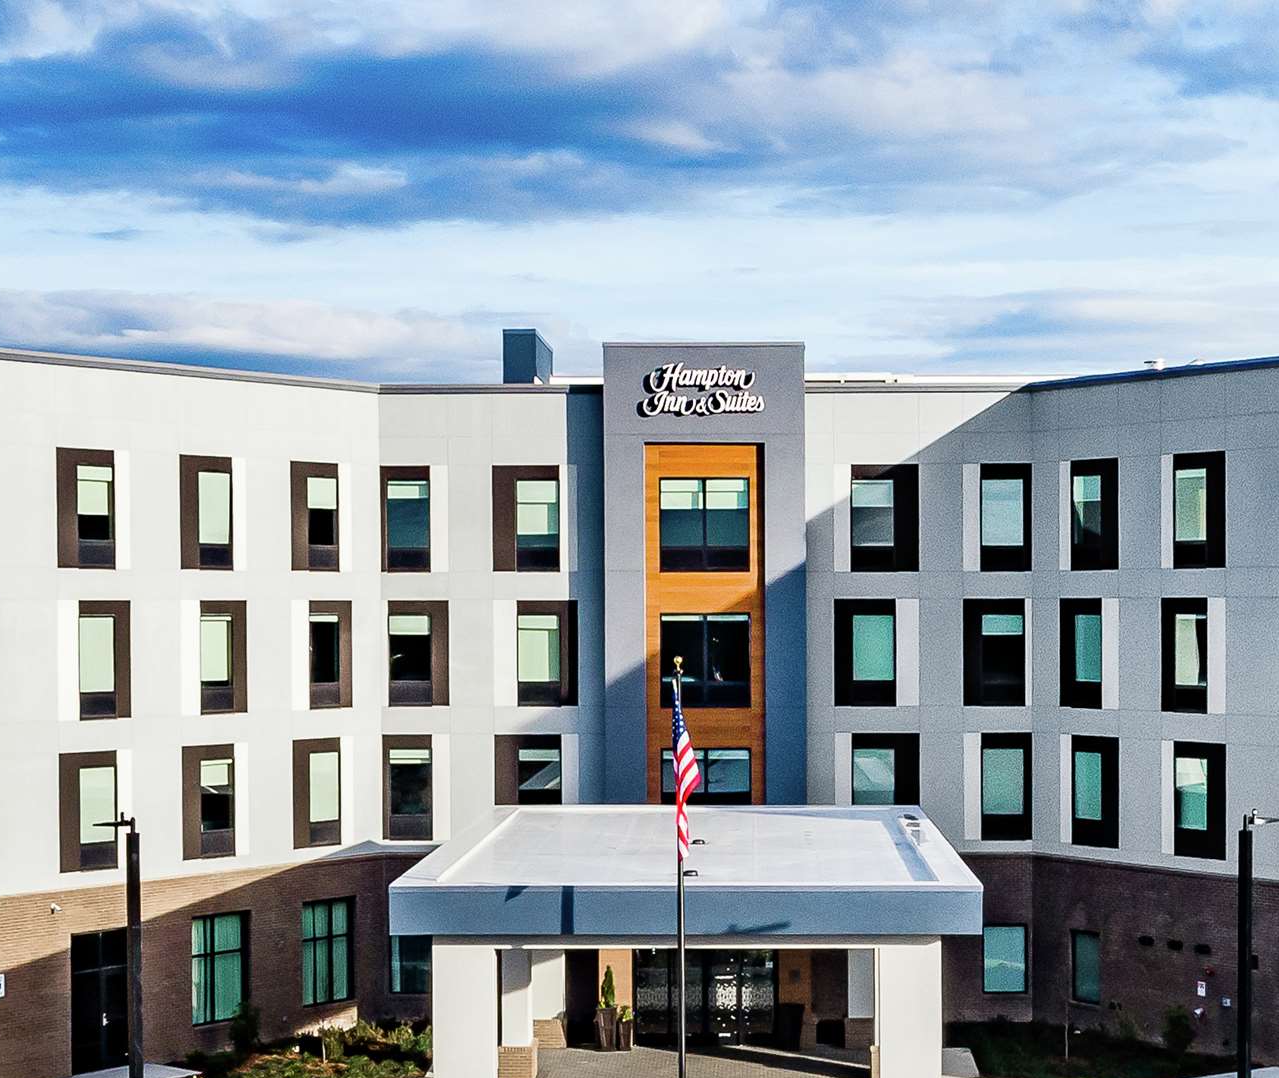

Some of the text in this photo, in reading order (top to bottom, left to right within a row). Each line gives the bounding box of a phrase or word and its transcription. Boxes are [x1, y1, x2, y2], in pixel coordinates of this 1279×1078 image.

[650, 362, 755, 392] Hampton
[643, 391, 696, 416] Inn
[707, 390, 765, 414] Suites
